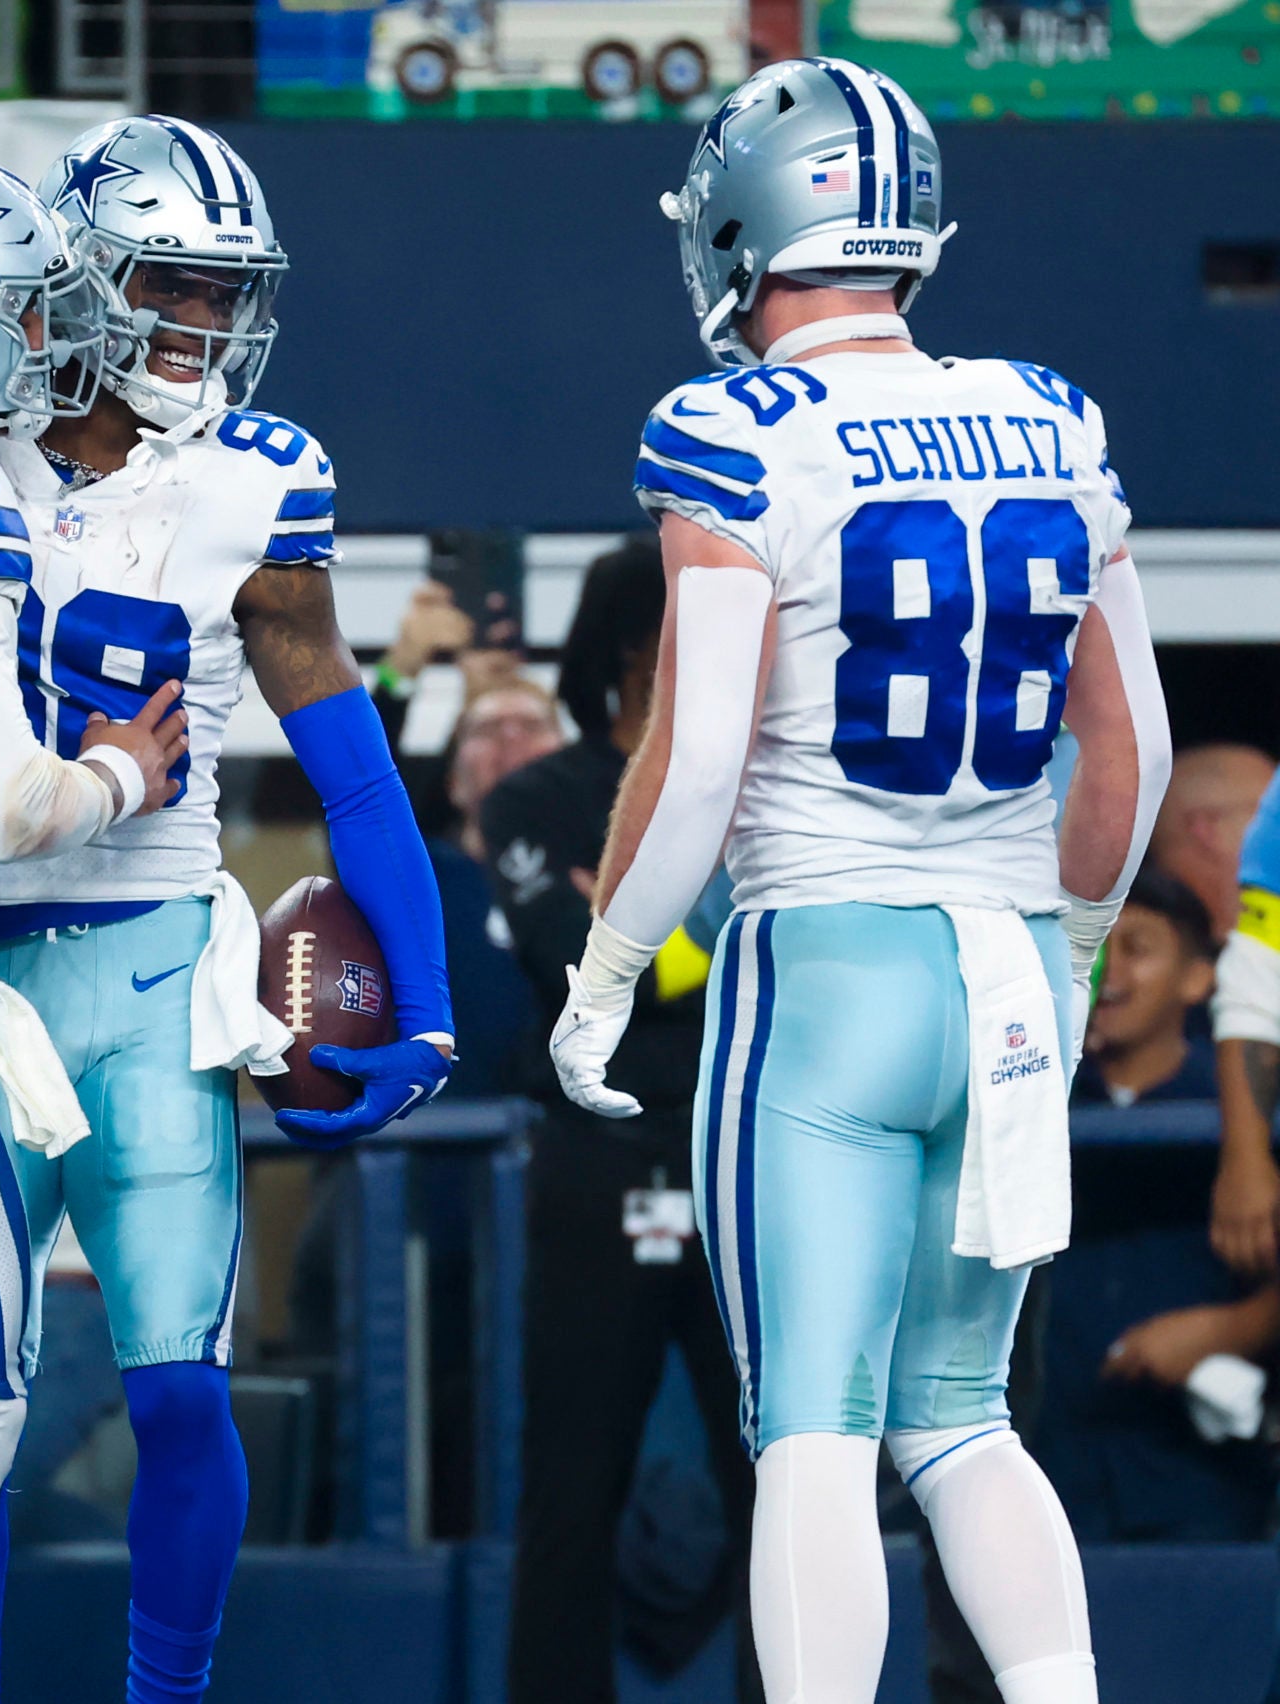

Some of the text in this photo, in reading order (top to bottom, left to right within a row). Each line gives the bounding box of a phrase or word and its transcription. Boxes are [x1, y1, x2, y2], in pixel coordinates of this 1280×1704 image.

[215, 234, 253, 244] COWBOYS
[842, 239, 923, 257] COWBOYS
[216, 409, 310, 467] 8
[836, 415, 1074, 488] SCHULTZ
[59, 521, 78, 538] NFL
[831, 498, 1090, 796] 86
[17, 580, 192, 808] 8
[361, 973, 382, 1011] NFL
[997, 1047, 1039, 1067] INSPIRE
